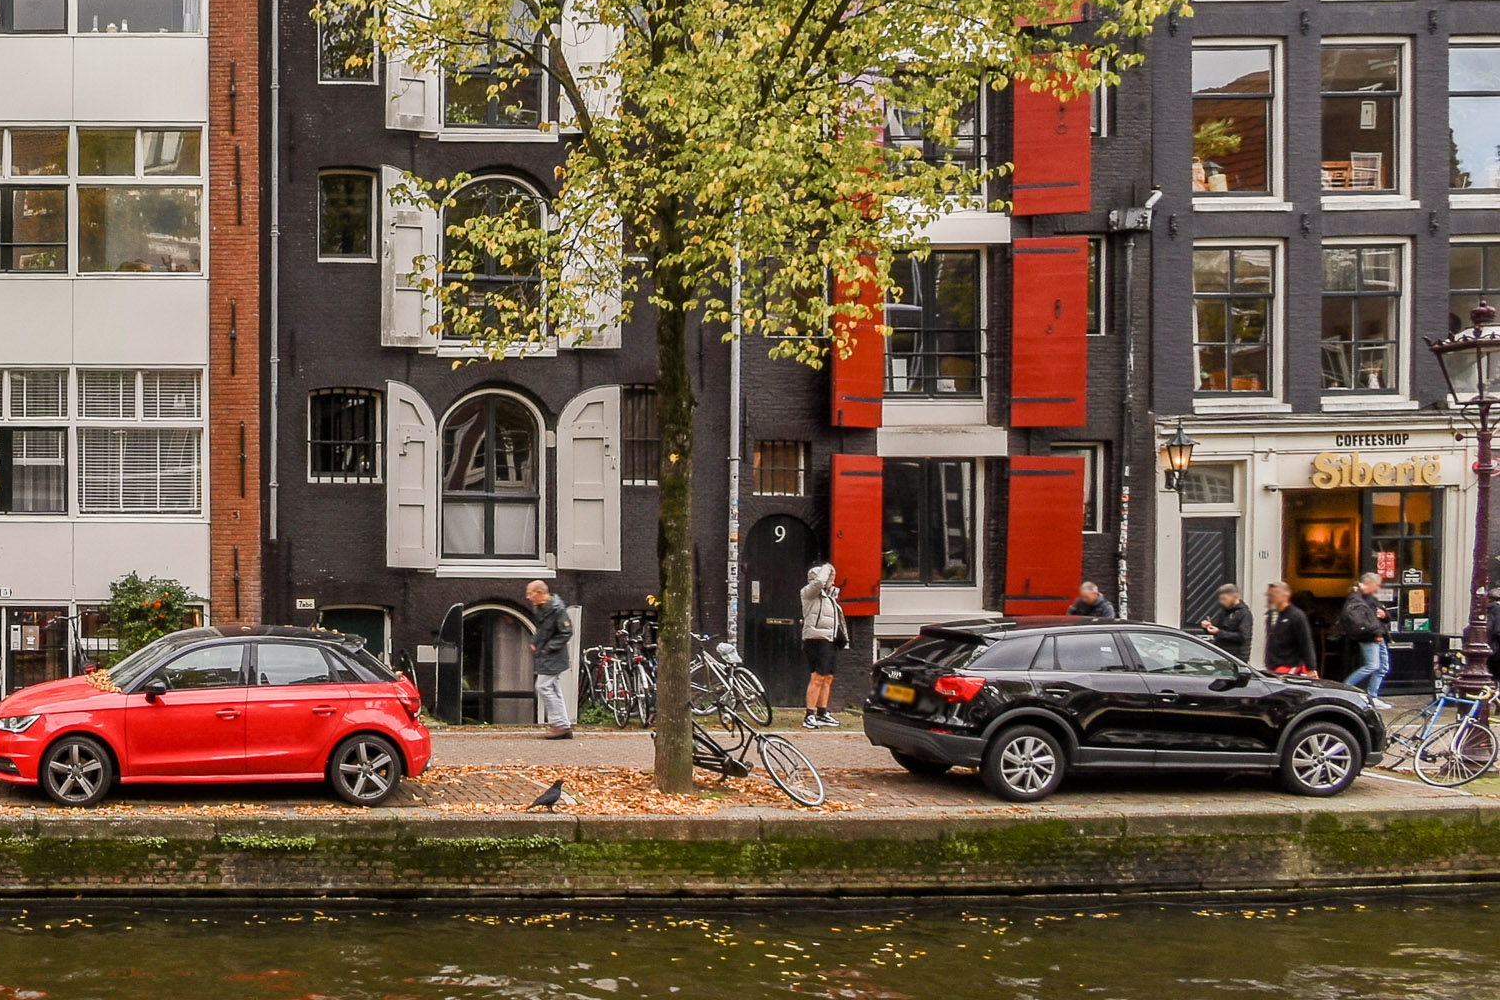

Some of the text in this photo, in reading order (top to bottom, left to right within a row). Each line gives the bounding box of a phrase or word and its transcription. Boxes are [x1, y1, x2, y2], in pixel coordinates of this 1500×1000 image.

[1336, 433, 1409, 446] COFFEESHOP
[1312, 452, 1441, 489] Siberië
[775, 525, 786, 543] 9
